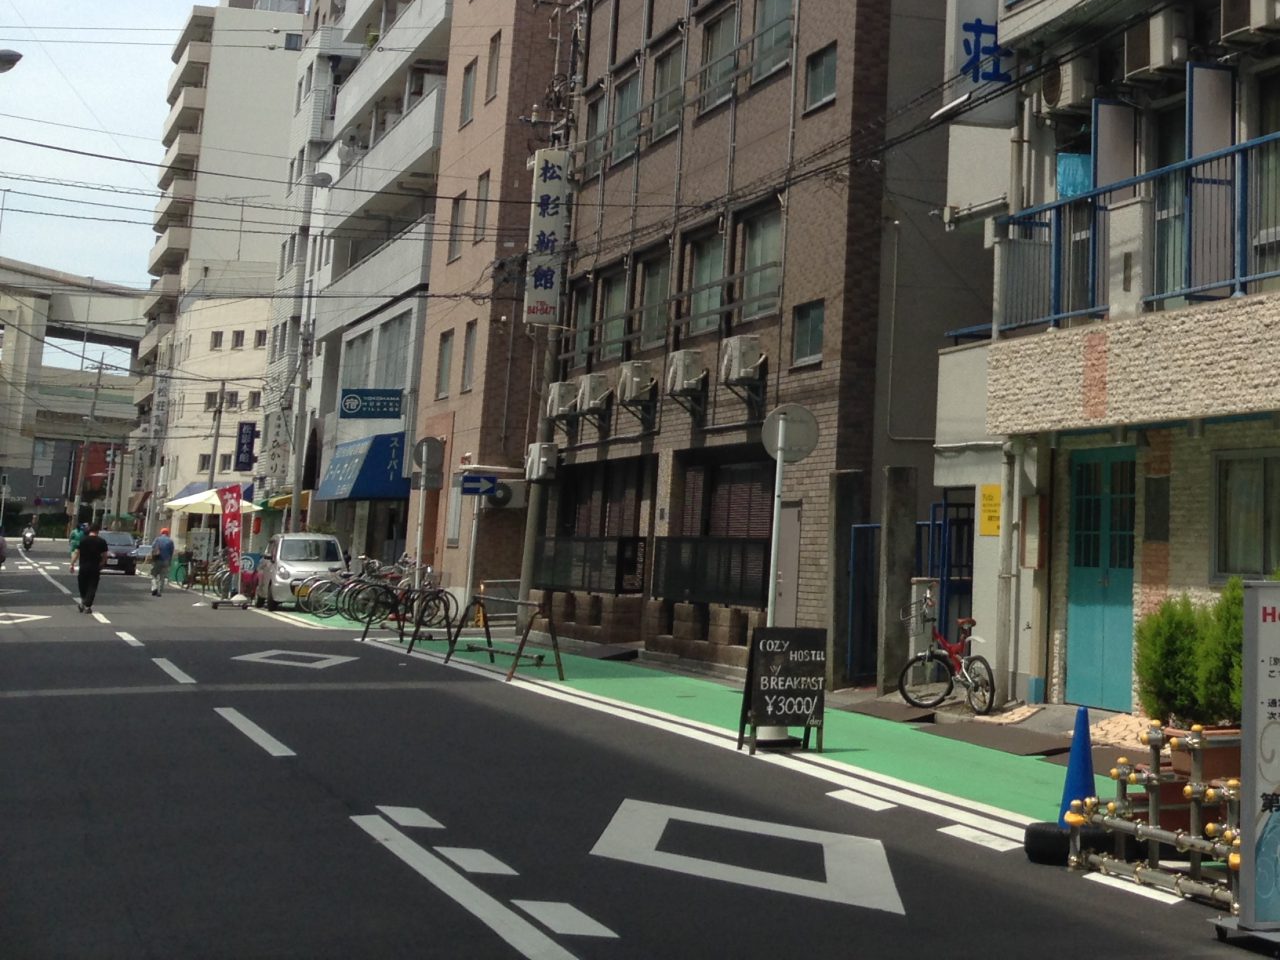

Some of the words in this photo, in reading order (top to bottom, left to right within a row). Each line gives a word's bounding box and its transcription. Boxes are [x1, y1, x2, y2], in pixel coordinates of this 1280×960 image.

[532, 159, 562, 290] 松影新館
[387, 437, 399, 481] スーパー
[760, 640, 790, 651] COZY
[789, 650, 825, 661] HOSTEL
[760, 676, 824, 690] BREAKFAST
